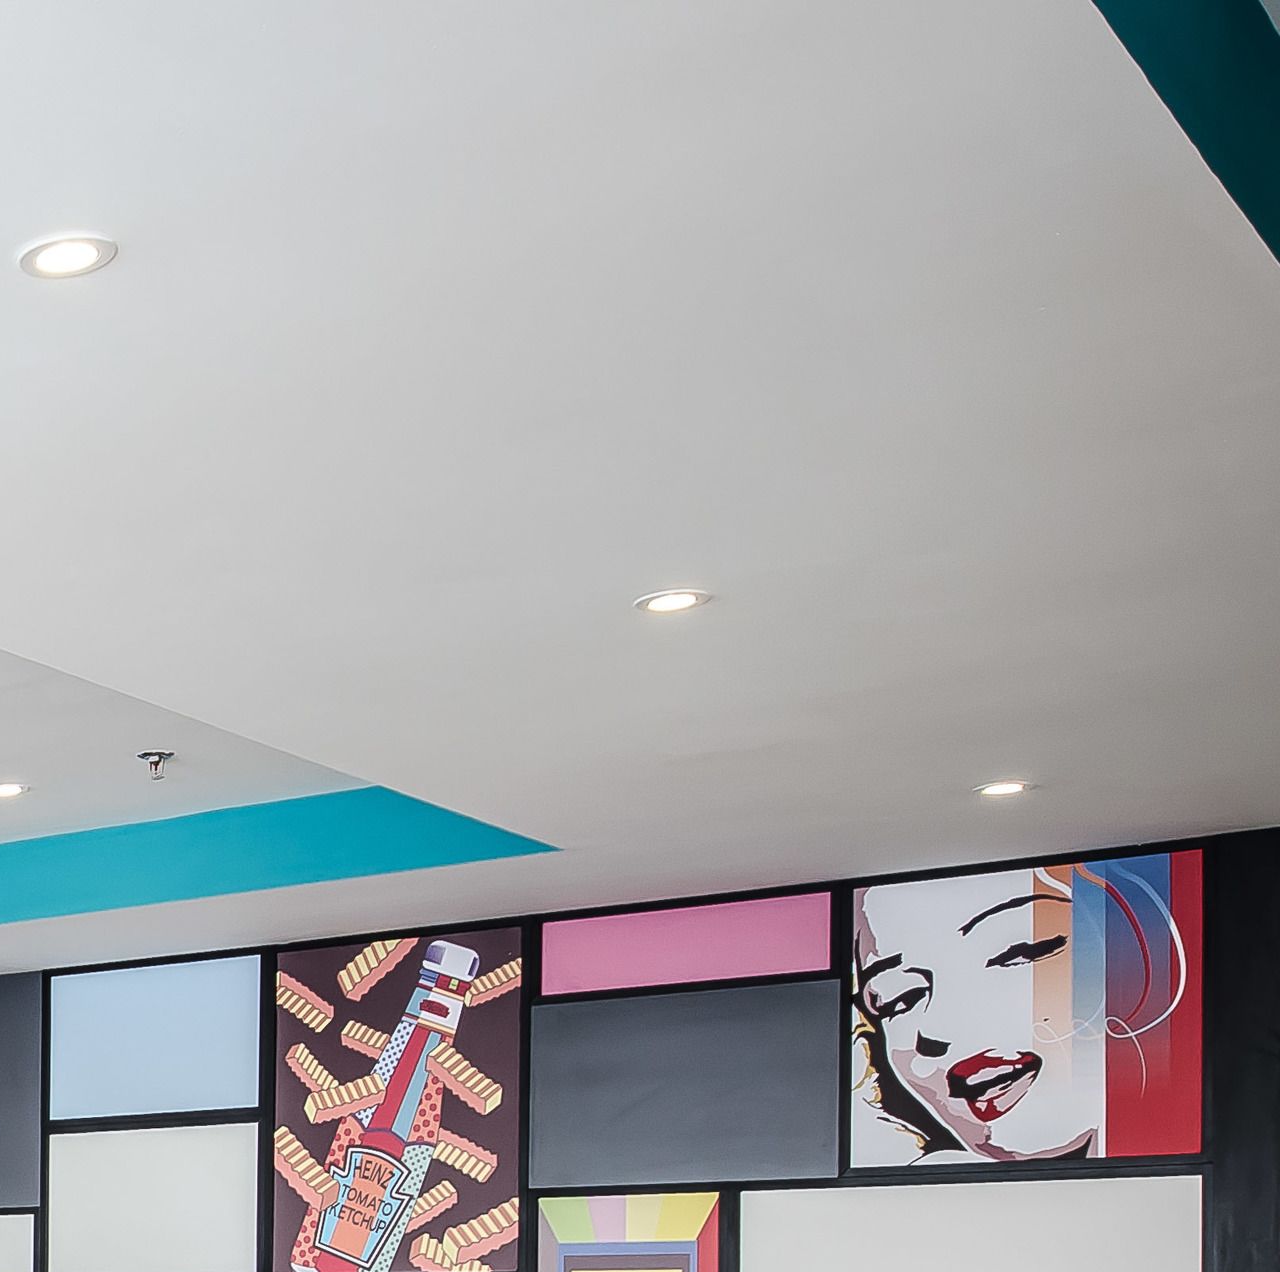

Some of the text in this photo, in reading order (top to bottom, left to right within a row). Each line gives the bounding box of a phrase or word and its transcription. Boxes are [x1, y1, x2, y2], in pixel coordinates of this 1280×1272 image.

[353, 1158, 396, 1190] HEINZ
[342, 1183, 393, 1217] TOMATO
[328, 1202, 387, 1234] KETCHUP
